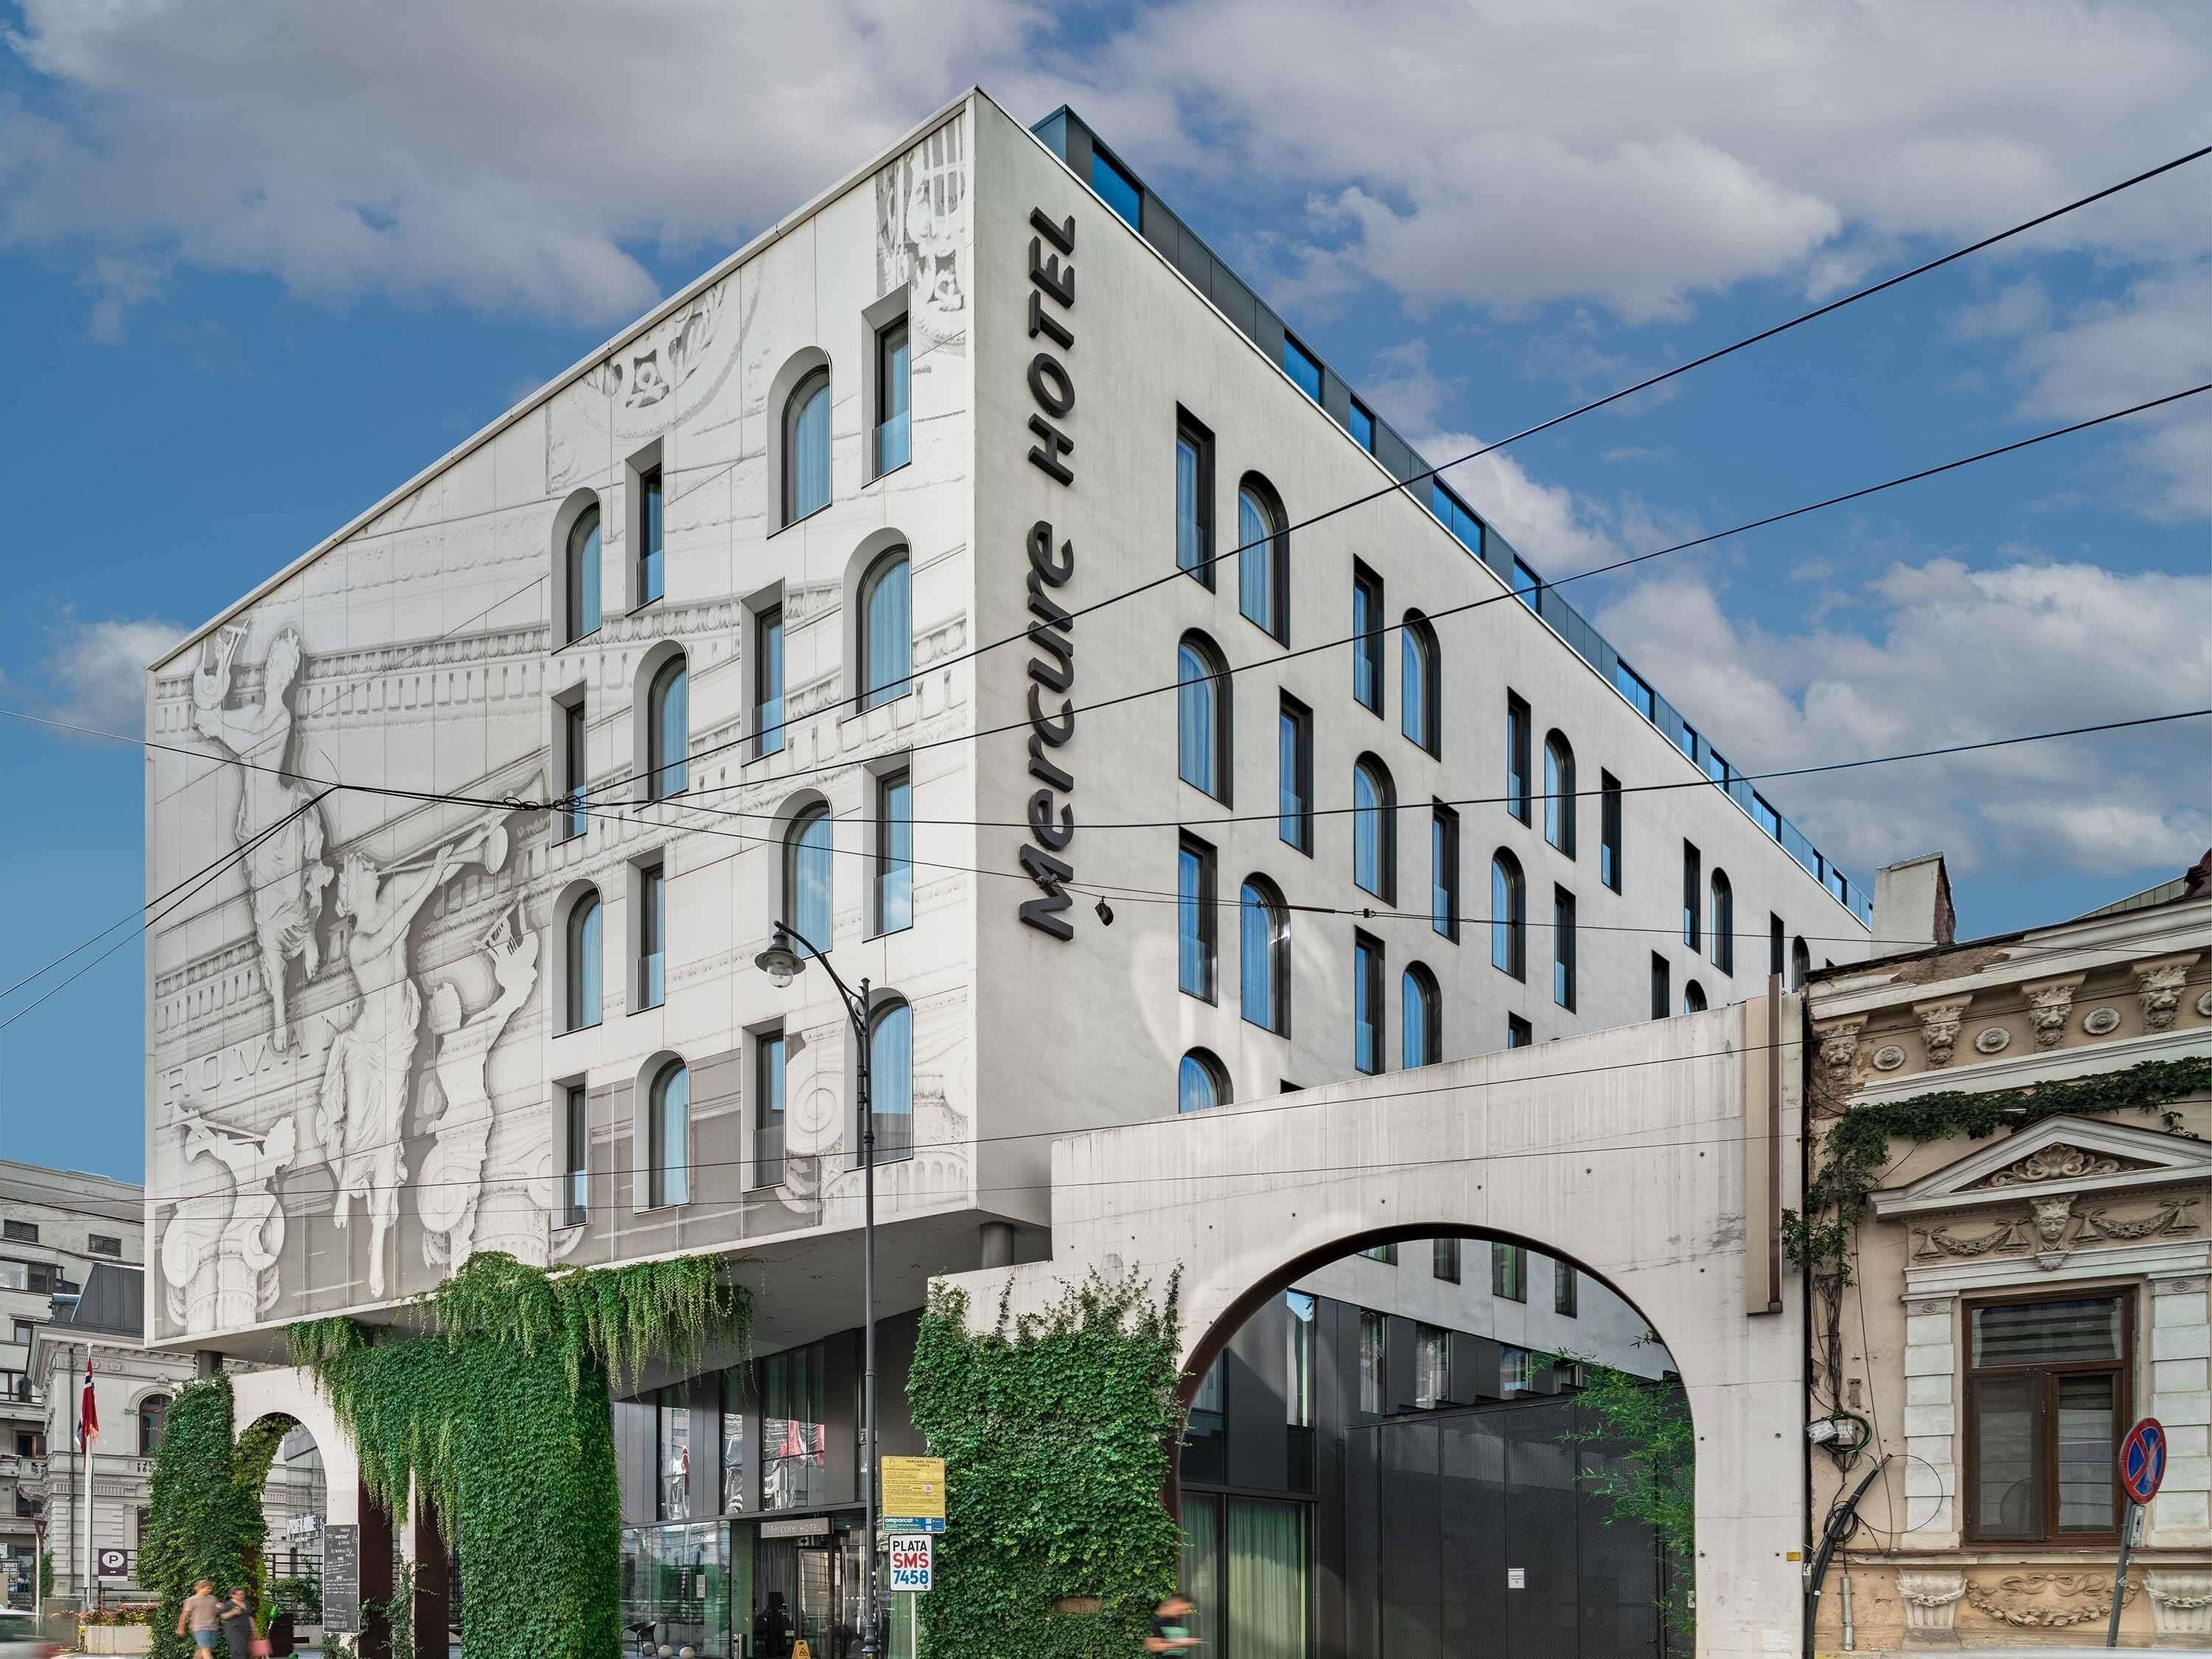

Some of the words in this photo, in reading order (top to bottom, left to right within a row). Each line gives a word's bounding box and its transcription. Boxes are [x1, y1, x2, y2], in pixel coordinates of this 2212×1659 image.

[1027, 206, 1076, 487] HOTEL
[1019, 520, 1075, 942] Mercure
[767, 1524, 796, 1534] Mercure
[799, 1523, 821, 1533] HOTEL
[893, 1540, 928, 1551] PLATA
[109, 1555, 119, 1564] P
[893, 1552, 929, 1568] SMS
[893, 1570, 929, 1585] 7458
